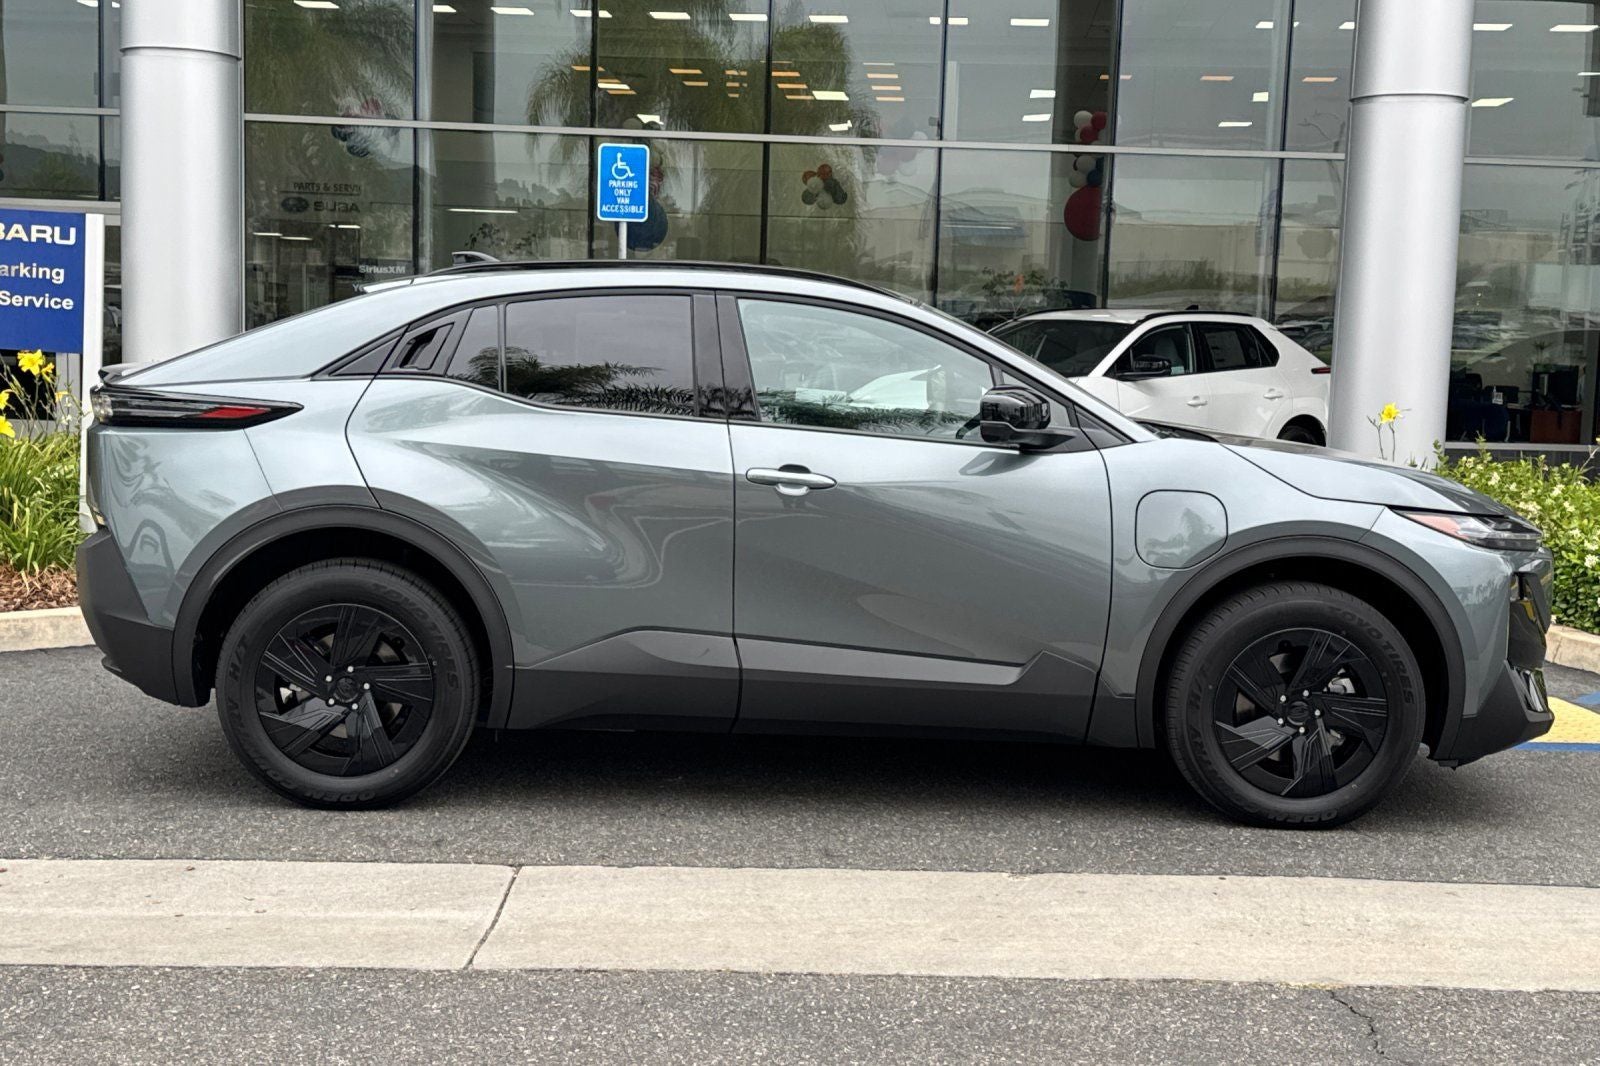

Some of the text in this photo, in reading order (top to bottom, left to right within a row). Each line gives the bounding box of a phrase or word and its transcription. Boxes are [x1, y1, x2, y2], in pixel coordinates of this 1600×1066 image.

[608, 180, 638, 188] PARKING
[614, 189, 632, 197] ONLY
[601, 204, 644, 213] ACCESSIBLE
[0, 222, 76, 245] ARU
[358, 265, 406, 274] SiriusXM
[0, 290, 74, 310] Service
[1382, 642, 1415, 705] TIRES
